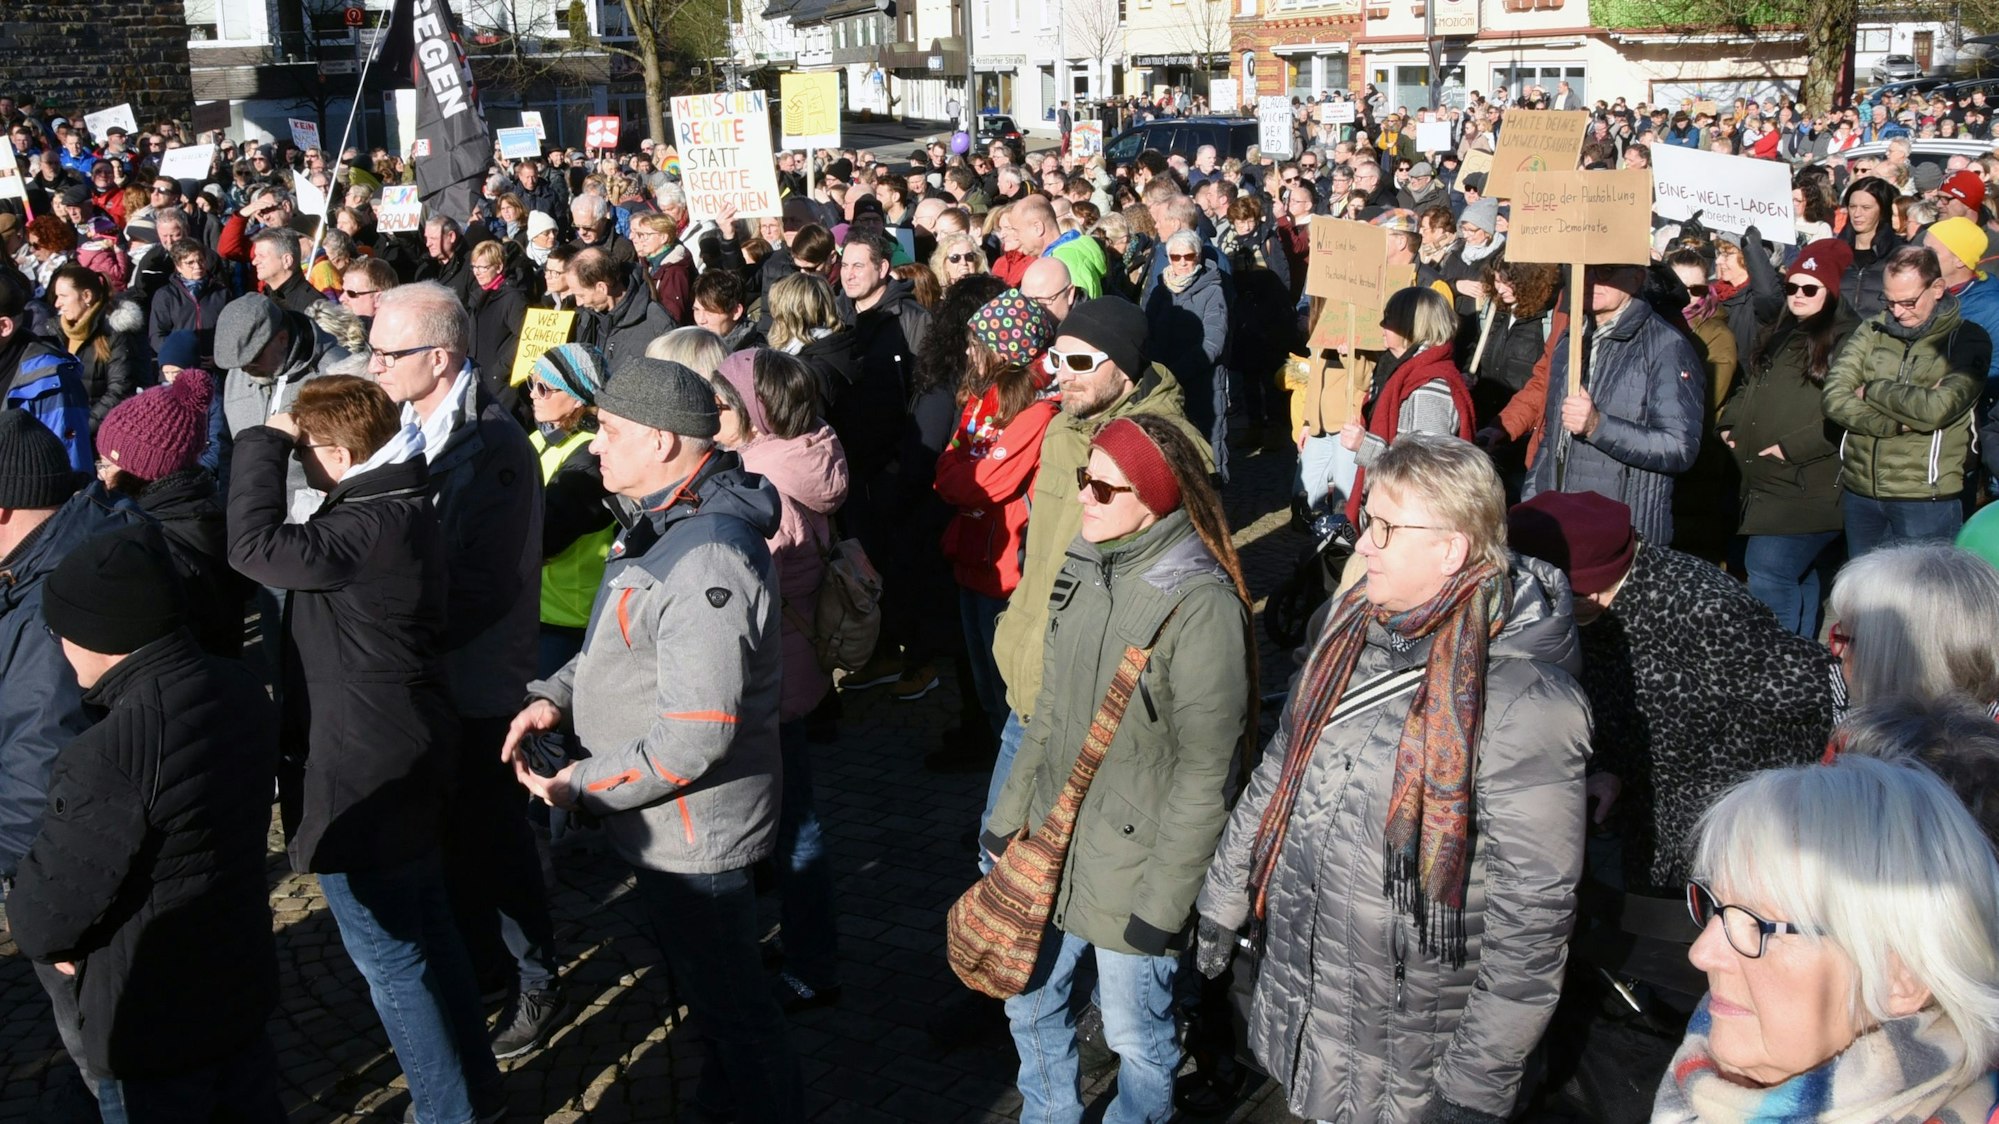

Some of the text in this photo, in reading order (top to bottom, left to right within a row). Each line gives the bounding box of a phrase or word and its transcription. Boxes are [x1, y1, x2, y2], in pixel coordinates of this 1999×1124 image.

[677, 91, 764, 120] MENSCHEN
[681, 119, 744, 145] RECHTE
[1265, 126, 1282, 137] DER
[1506, 115, 1578, 133] HALTE DEINE
[1265, 139, 1282, 151] AFD
[688, 148, 740, 170] STATT
[689, 170, 751, 192] RECHTE
[1522, 182, 1556, 208] Stopp
[1560, 184, 1578, 204] der
[379, 213, 419, 231] BRAUN
[1521, 224, 1553, 235] unserer
[537, 312, 559, 326] WER
[522, 326, 566, 343] SCHWEIGT
